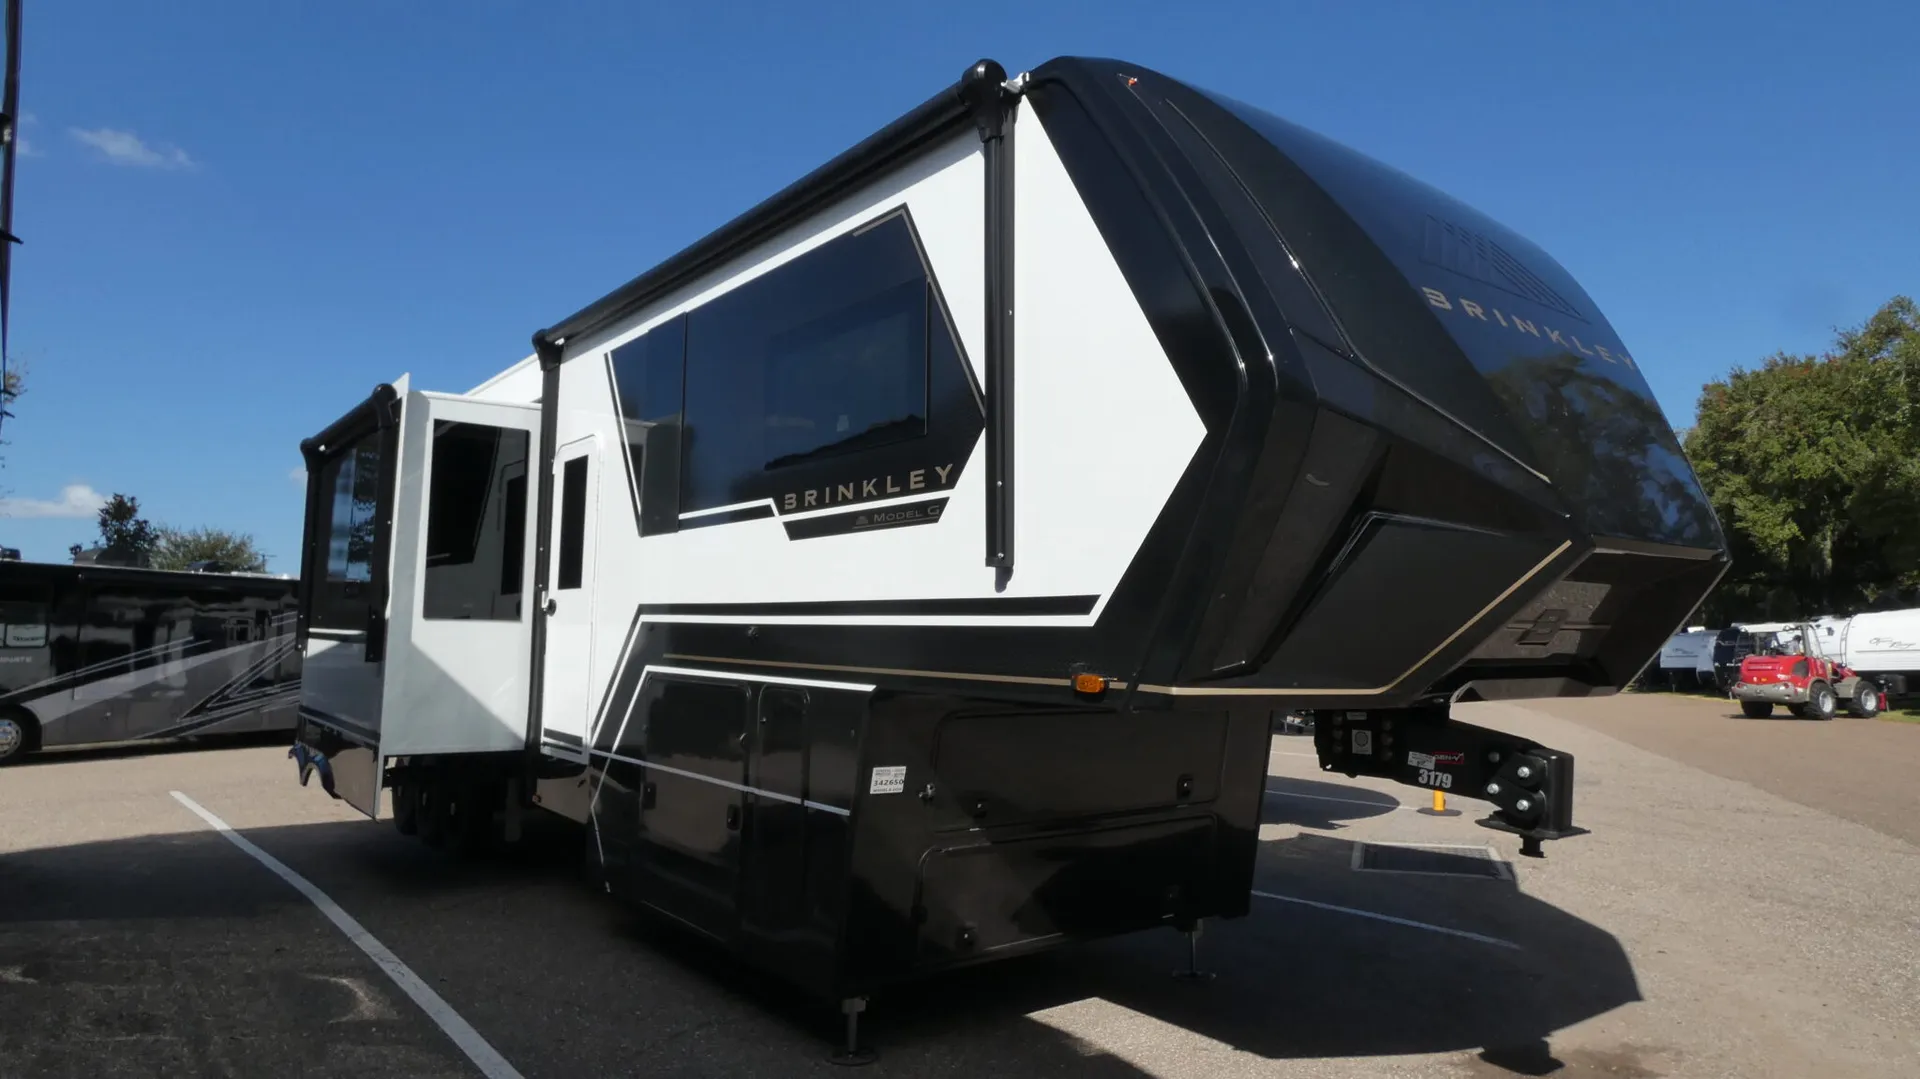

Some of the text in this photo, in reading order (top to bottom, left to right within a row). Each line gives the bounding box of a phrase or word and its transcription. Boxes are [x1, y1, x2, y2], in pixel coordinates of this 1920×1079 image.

[1421, 286, 1635, 370] BRINKLEY
[784, 463, 953, 510] BRINKLEY
[873, 778, 904, 787] 342650
[1418, 768, 1453, 789] 3179
